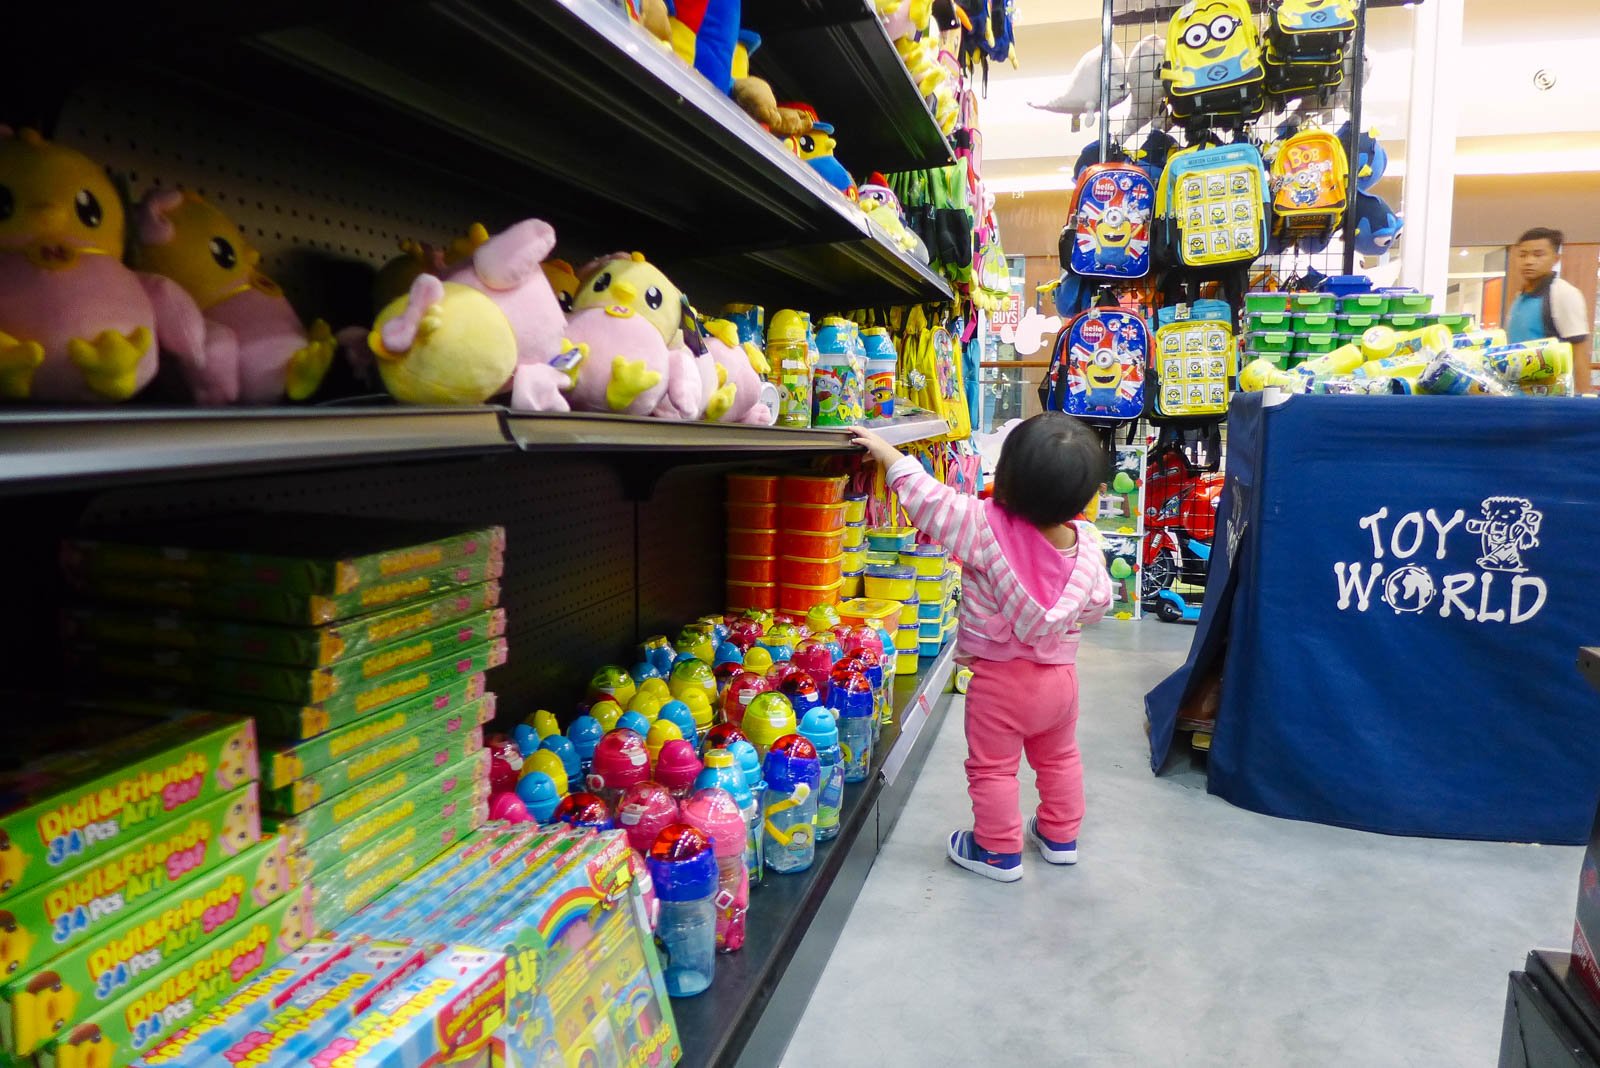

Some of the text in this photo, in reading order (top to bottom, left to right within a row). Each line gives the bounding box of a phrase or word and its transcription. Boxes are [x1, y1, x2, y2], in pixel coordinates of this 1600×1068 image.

[992, 311, 1018, 324] BUYS
[1083, 321, 1103, 332] hello
[1359, 506, 1464, 560] TOY
[47, 827, 84, 865] 34
[84, 818, 120, 847] Pcs
[119, 794, 160, 830] Art
[52, 904, 88, 944] 34
[88, 892, 125, 922] Pcs
[125, 866, 165, 902] Art
[94, 961, 129, 999] 34
[129, 948, 163, 978] Pcs
[162, 920, 200, 958] Art
[132, 1011, 165, 1050] 34
[163, 998, 195, 1028] Pcs
[194, 969, 229, 1006] Art
